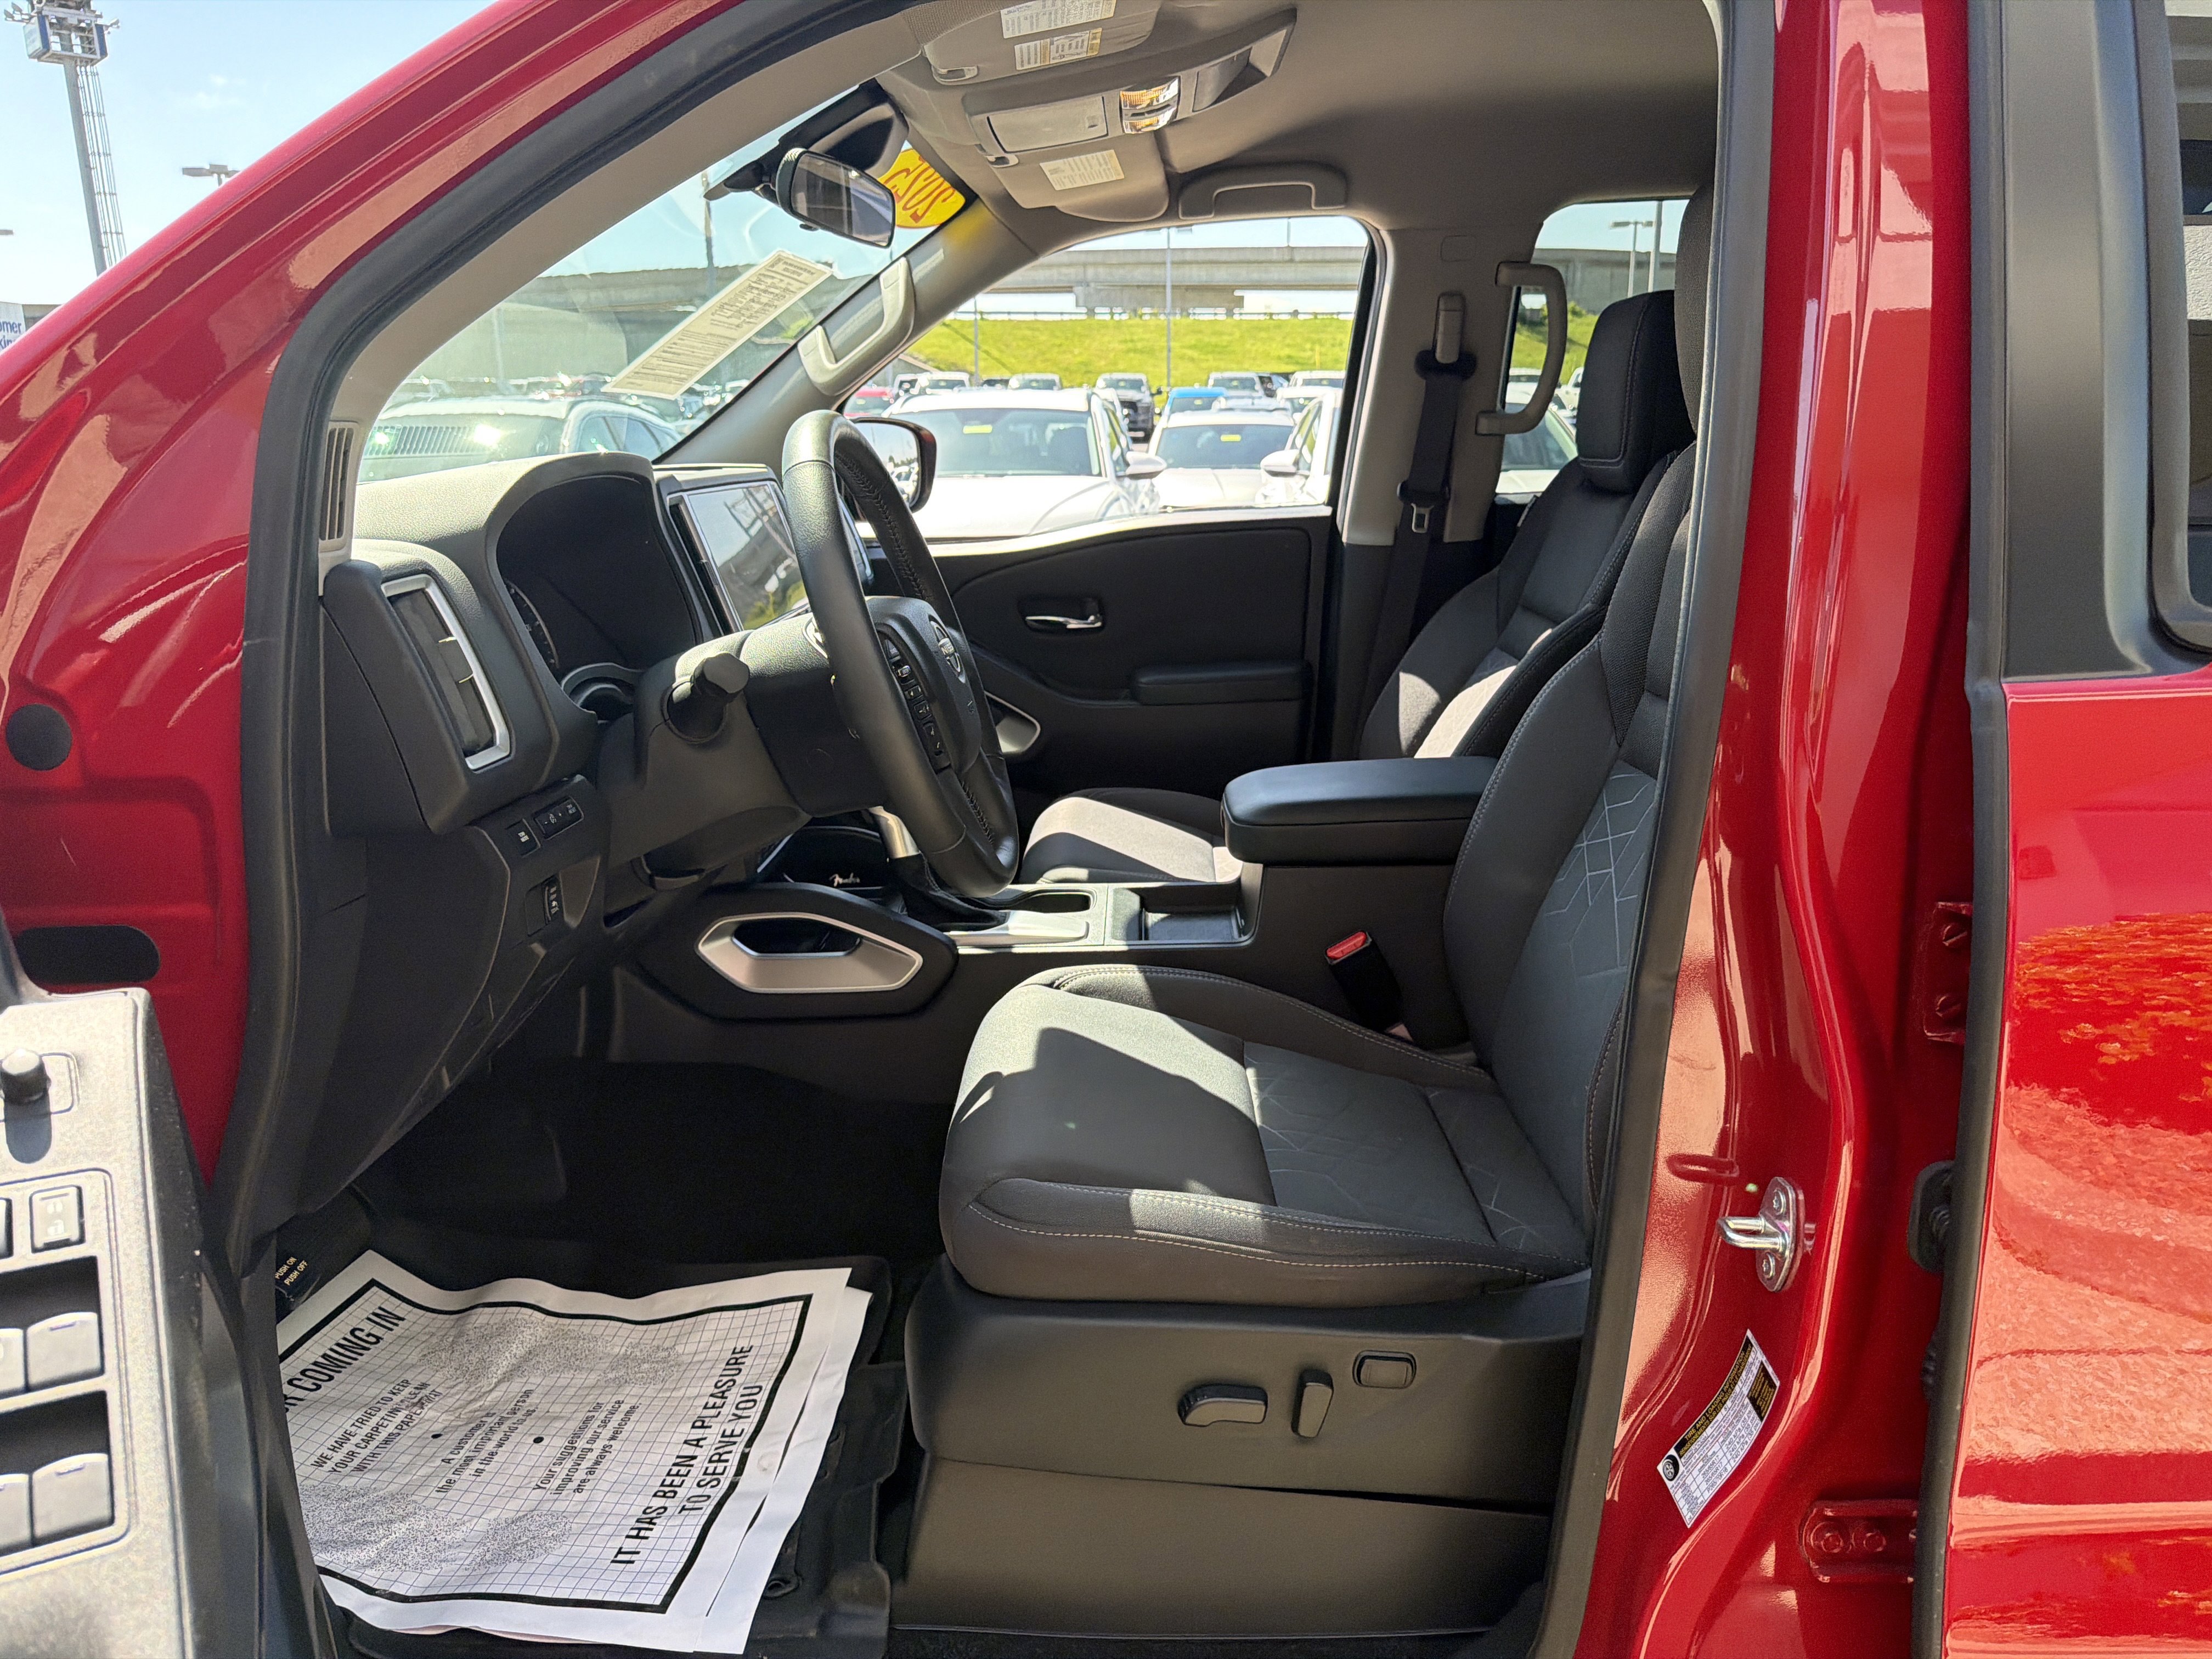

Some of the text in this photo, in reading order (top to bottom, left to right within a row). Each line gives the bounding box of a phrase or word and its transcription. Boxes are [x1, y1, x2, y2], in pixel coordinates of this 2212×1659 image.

[275, 1257, 297, 1279] PUSH ON
[284, 1260, 308, 1285] PUSH OFF
[286, 1327, 383, 1392] COMING
[365, 1306, 406, 1331] IN
[311, 1379, 412, 1468] WE HAVE TRIED TO KEEP
[1684, 1427, 1696, 1440] TIRE
[1696, 1416, 1706, 1430] AND
[1706, 1391, 1724, 1418] LOADING
[1723, 1351, 1745, 1392] INFORMATION
[328, 1449, 361, 1473] YOUR
[351, 1451, 382, 1473] WITH
[374, 1432, 401, 1452] THIS
[435, 1389, 534, 1493] the most important person
[450, 1419, 488, 1455] customer
[469, 1468, 486, 1477] in
[478, 1451, 498, 1465] the
[493, 1426, 518, 1448] world
[532, 1402, 605, 1490] Your suggestions for
[550, 1400, 624, 1495] improving our service
[573, 1403, 642, 1493] are always welcome.
[610, 1344, 754, 1564] IT HAS BEEN A PLEASURE
[678, 1384, 763, 1514] TO SERVE YOU
[1725, 1437, 1733, 1449] 240
[1729, 1444, 1737, 1456] 240
[1732, 1451, 1740, 1463] 240
